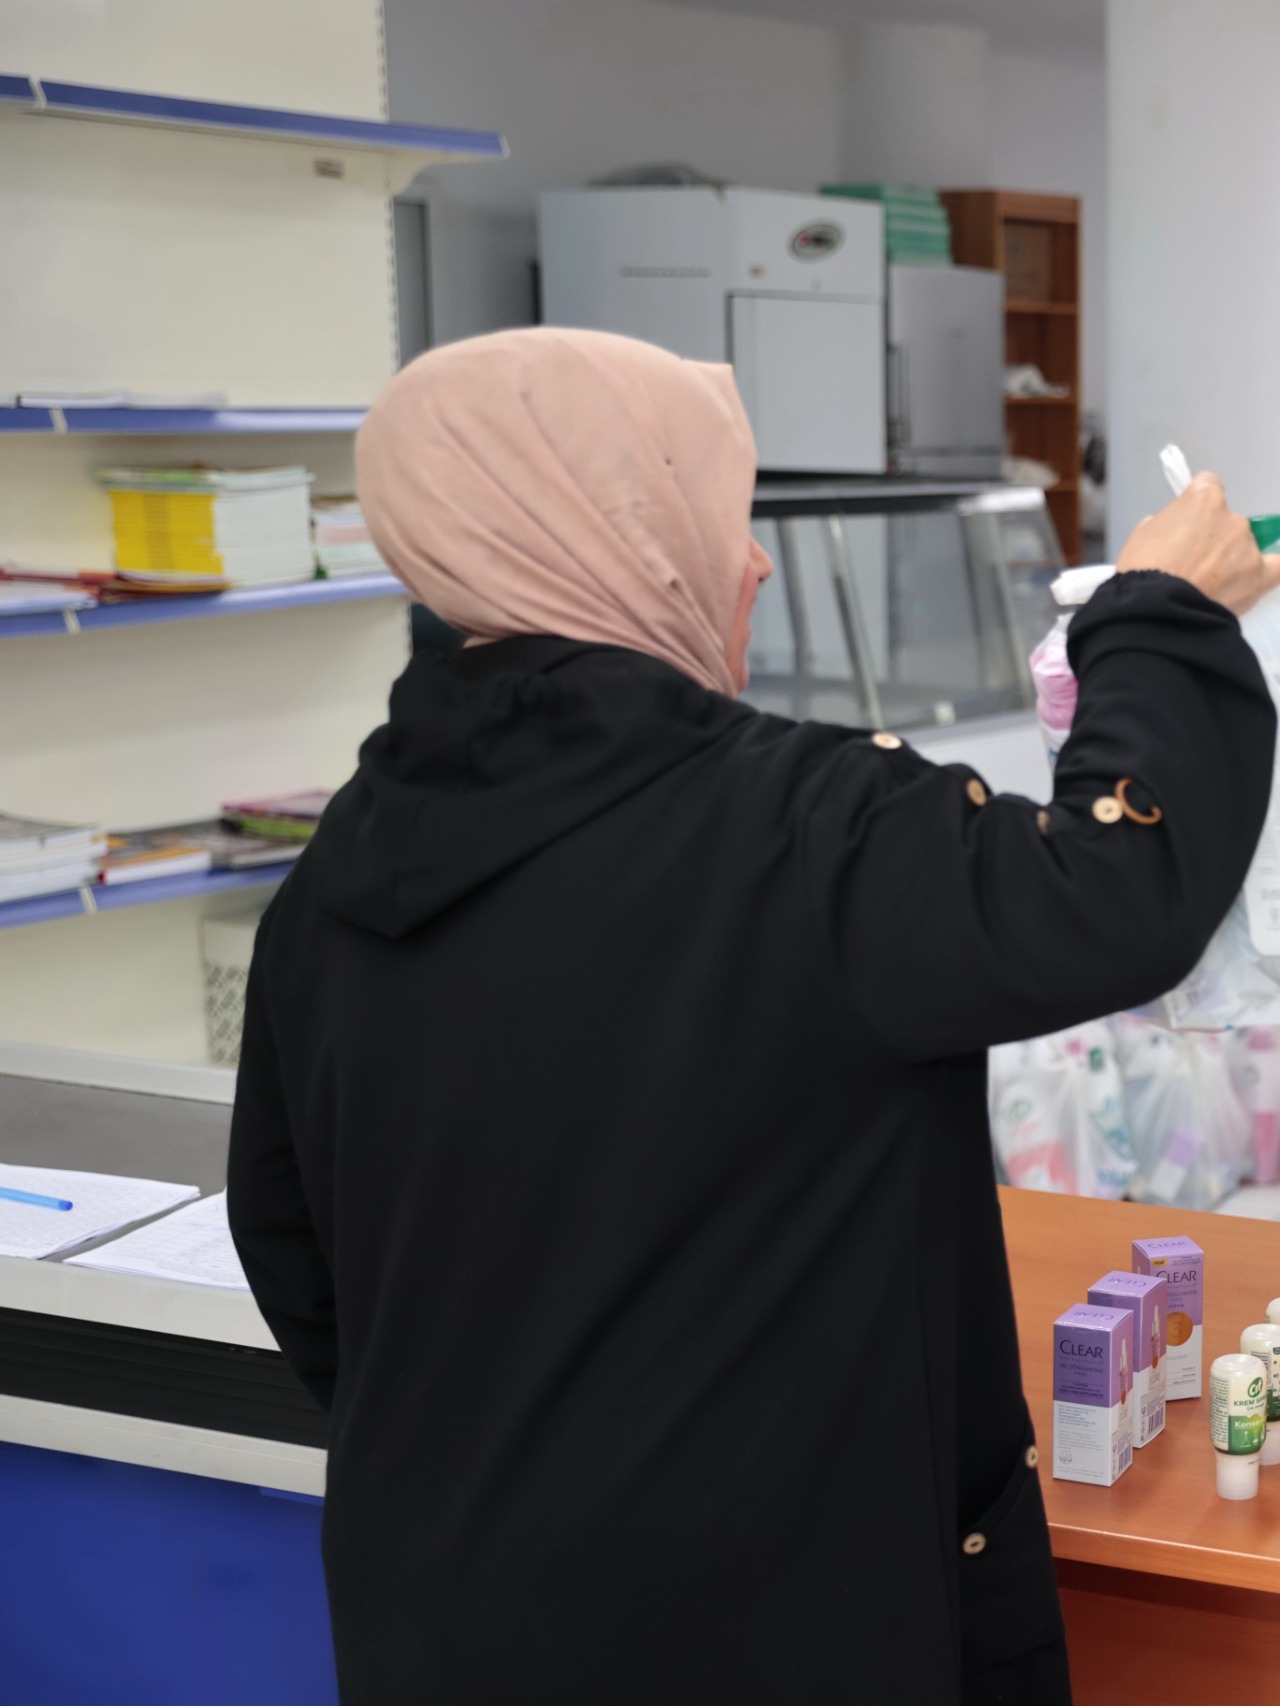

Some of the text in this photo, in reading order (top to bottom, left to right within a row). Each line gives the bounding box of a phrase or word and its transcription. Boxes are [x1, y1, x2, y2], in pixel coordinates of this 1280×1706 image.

[1156, 1270, 1197, 1284] CLEAR
[1060, 1339, 1104, 1359] CLEAR
[1233, 1399, 1255, 1407] KREM
